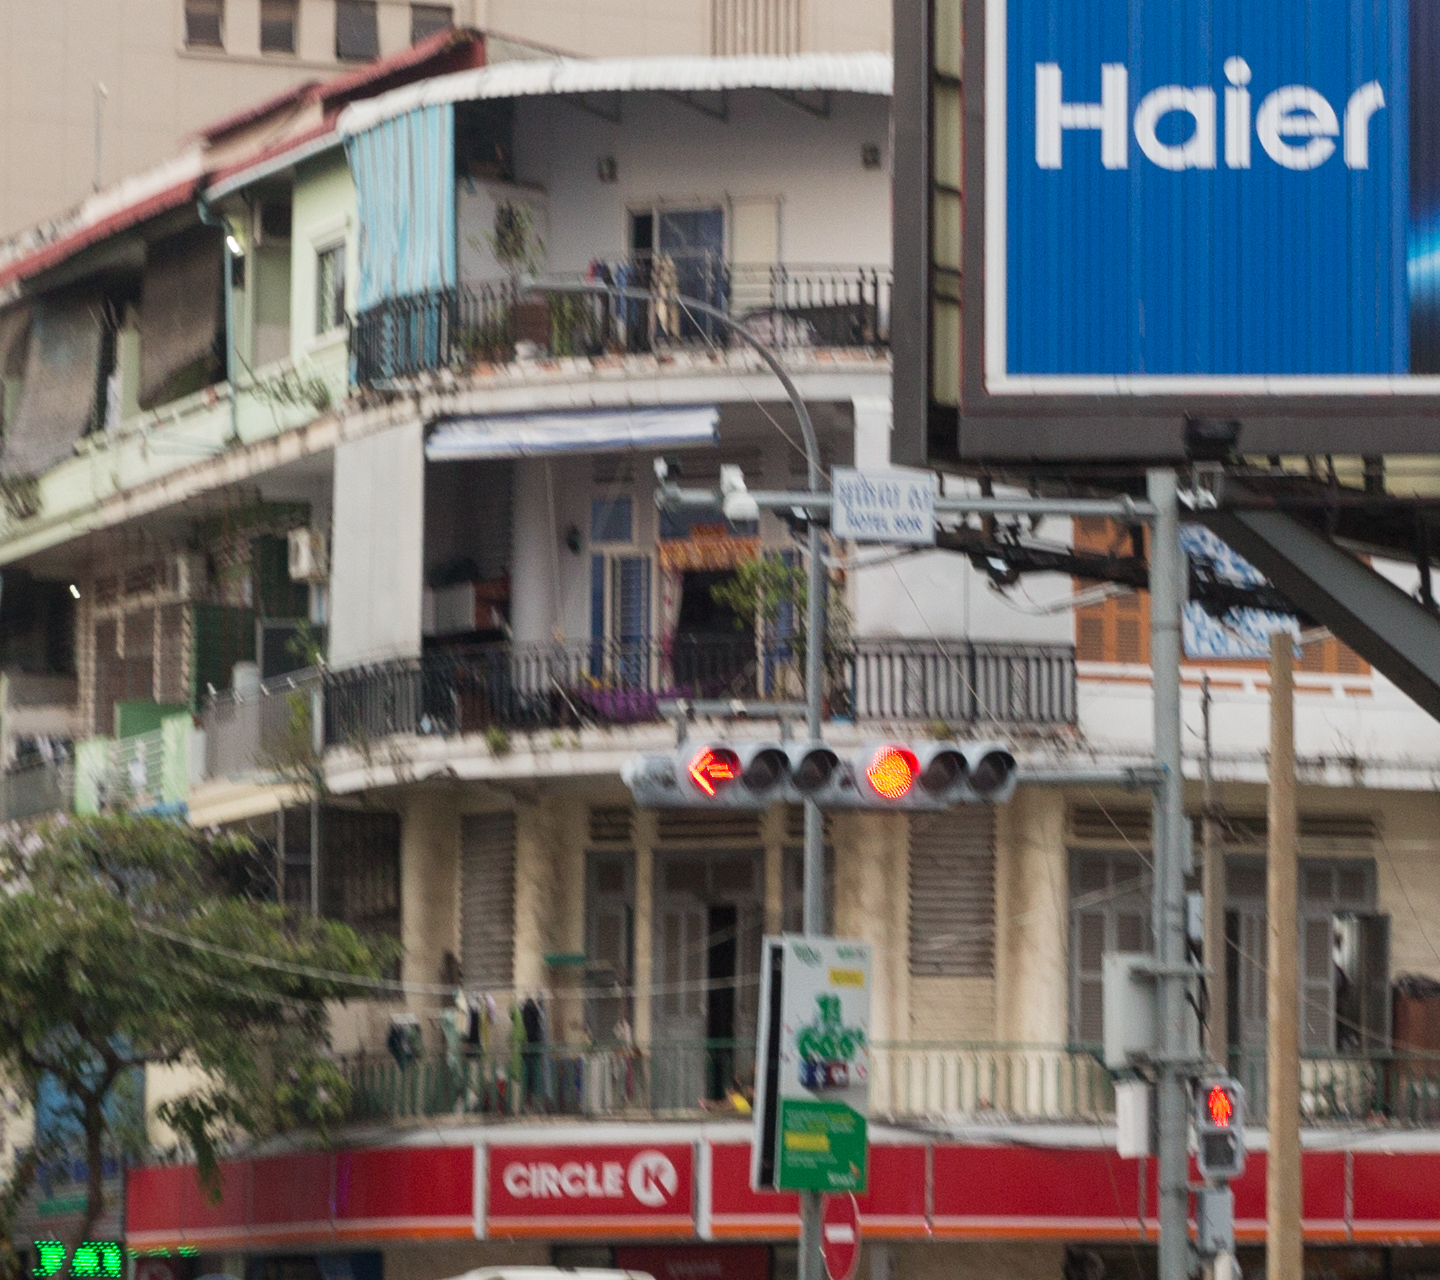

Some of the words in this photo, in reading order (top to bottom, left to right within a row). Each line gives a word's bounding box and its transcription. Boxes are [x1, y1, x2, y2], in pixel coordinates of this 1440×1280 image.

[1035, 55, 1387, 172] Haier
[502, 1160, 625, 1200] CIRCLE
[627, 1149, 679, 1208] K
